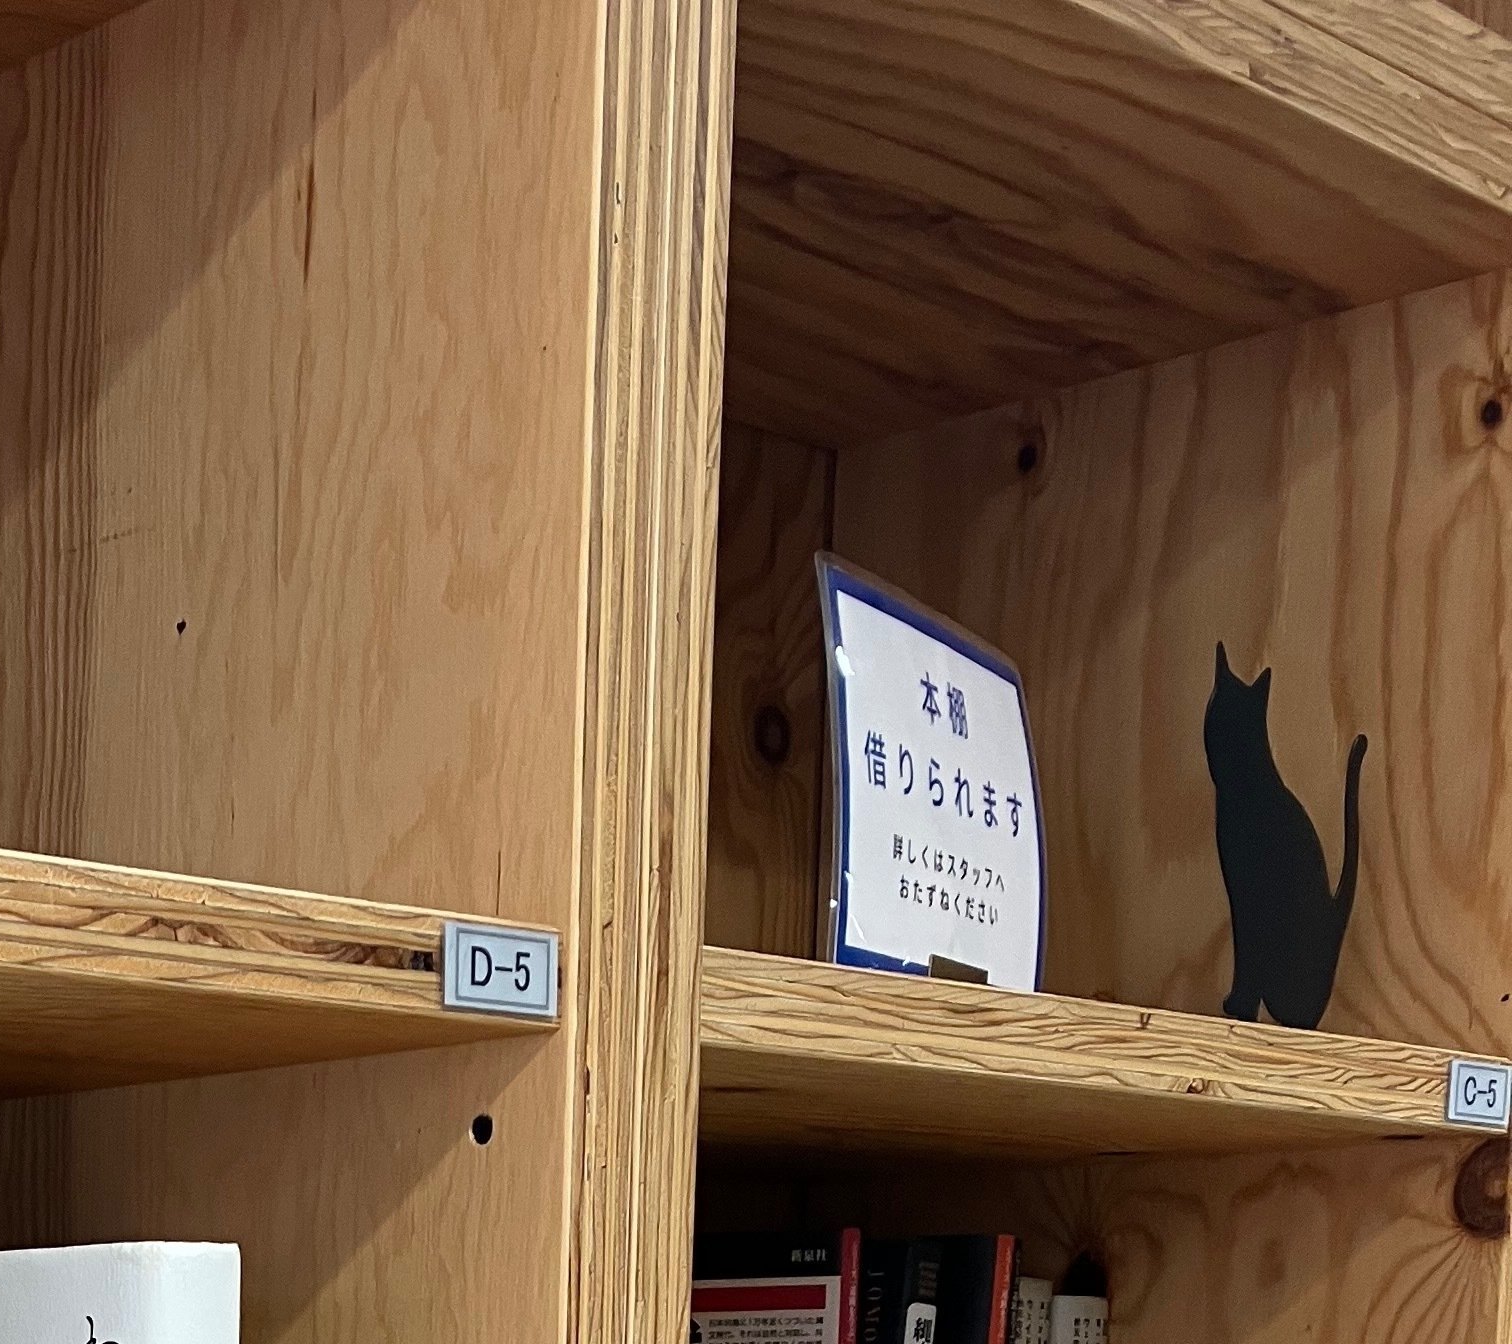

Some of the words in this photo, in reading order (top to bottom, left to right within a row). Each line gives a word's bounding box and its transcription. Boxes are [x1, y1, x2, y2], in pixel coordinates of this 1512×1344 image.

[920, 671, 969, 740] 本棚
[863, 729, 1023, 838] 借りられます
[892, 834, 1006, 893] 詳しくはスタッフへ
[897, 876, 1000, 927] おたずねください
[470, 944, 531, 992] D-5
[1463, 1075, 1498, 1109] C-5
